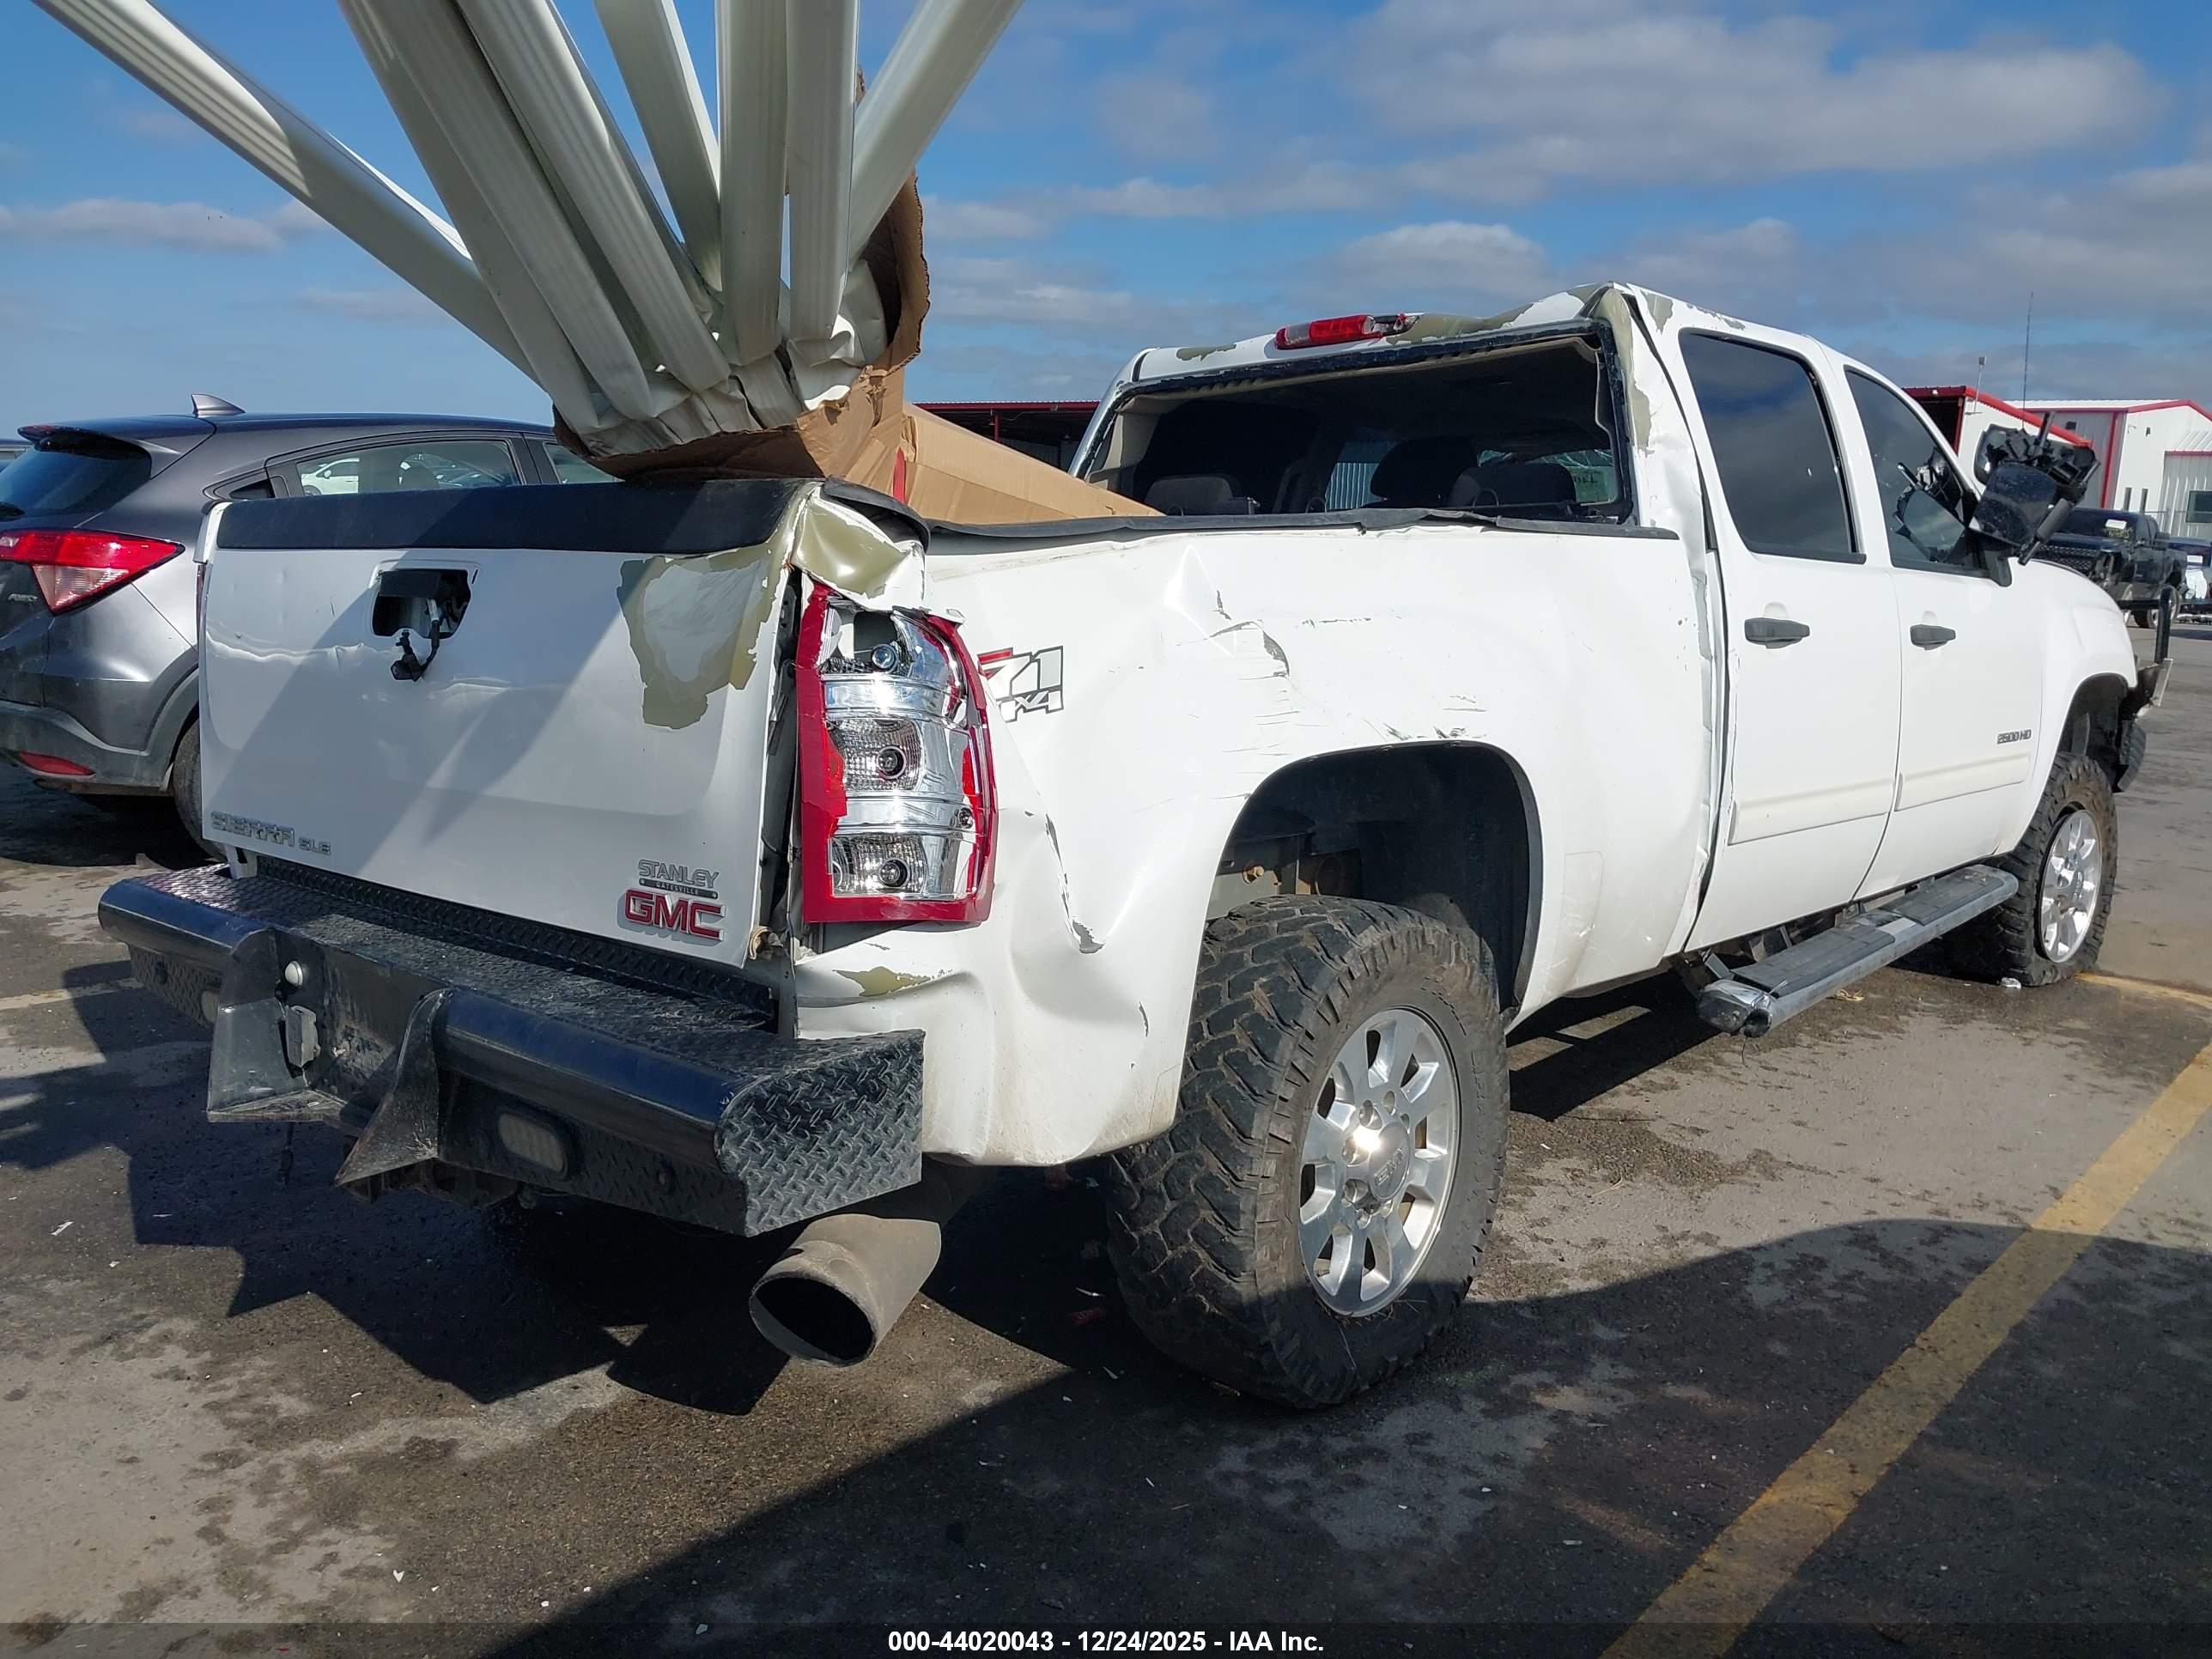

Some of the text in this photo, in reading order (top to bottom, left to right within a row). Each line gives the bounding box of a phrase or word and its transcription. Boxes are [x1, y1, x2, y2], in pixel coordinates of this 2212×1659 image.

[211, 811, 331, 855] SIERRA SLE
[638, 859, 720, 889] STANLEY
[655, 881, 700, 896] GATESVILLE
[625, 888, 726, 942] GMC
